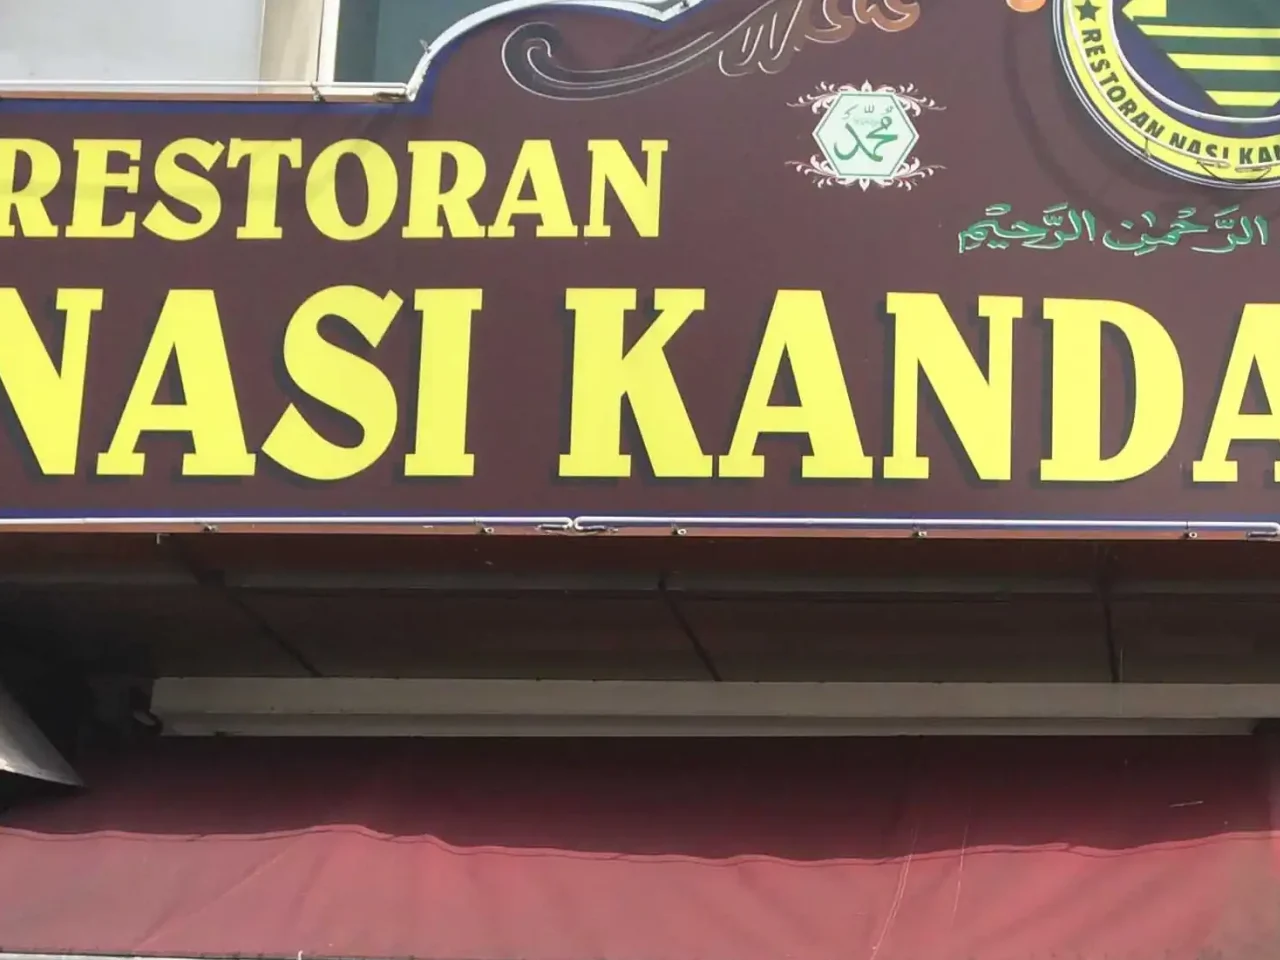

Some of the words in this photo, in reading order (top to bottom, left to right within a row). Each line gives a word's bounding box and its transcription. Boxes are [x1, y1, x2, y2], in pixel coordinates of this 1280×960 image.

[1082, 28, 1166, 138] RESTORAN
[1169, 132, 1229, 159] NASI
[0, 137, 668, 241] RESTORAN
[0, 284, 483, 481] NASI
